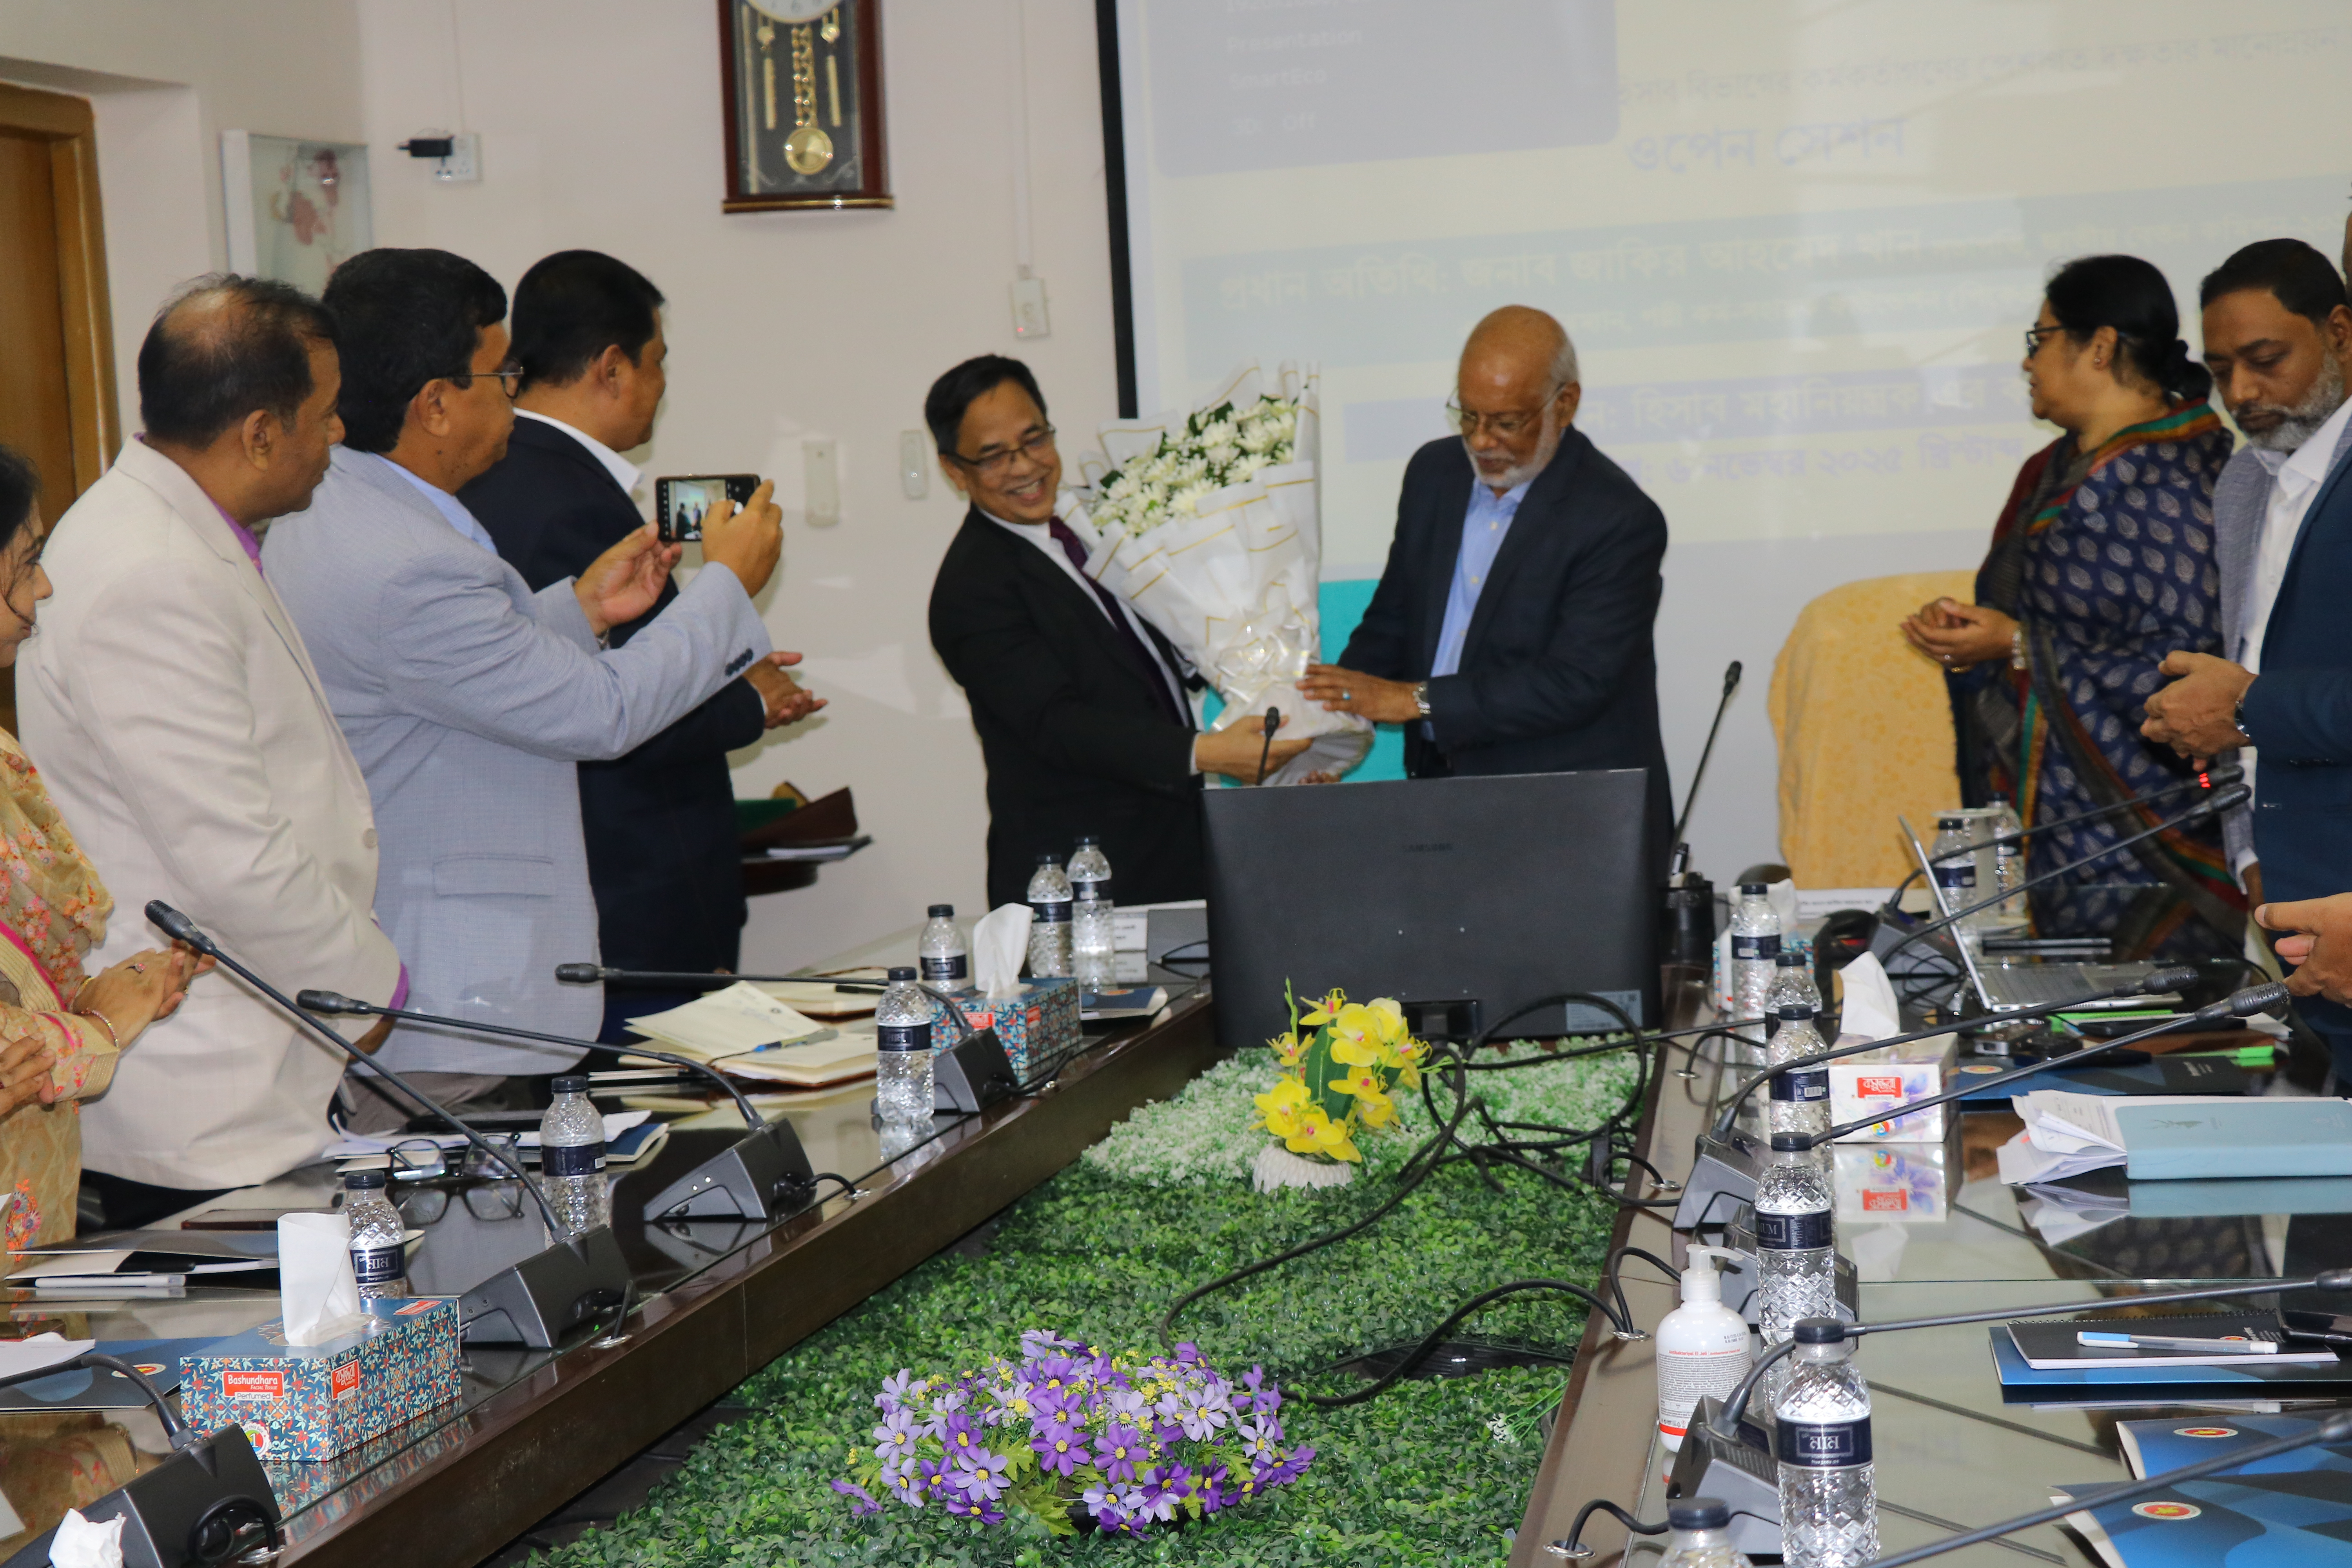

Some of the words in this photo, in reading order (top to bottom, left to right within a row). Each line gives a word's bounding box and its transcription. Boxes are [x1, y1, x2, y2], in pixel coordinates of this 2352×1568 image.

[1227, 29, 1363, 53] Presentation
[1229, 68, 1327, 91] SmartEco
[1282, 111, 1316, 132] Off
[1625, 125, 1761, 174] ওপেন
[1774, 116, 1910, 167] সেশন
[1220, 269, 1308, 312] প্রধান
[1460, 252, 1557, 289] জনাব
[1569, 236, 1688, 284] জাকির
[1700, 232, 1842, 276] আহমেদ
[1857, 226, 1922, 263] খান
[1631, 388, 1727, 429] হিসাব
[1702, 449, 1806, 481] নভেম্বর
[1817, 446, 1905, 479] ২০২৫
[228, 1374, 278, 1385] Bashundhara
[249, 1433, 259, 1448] 1
[1809, 1435, 1840, 1450] মাম
